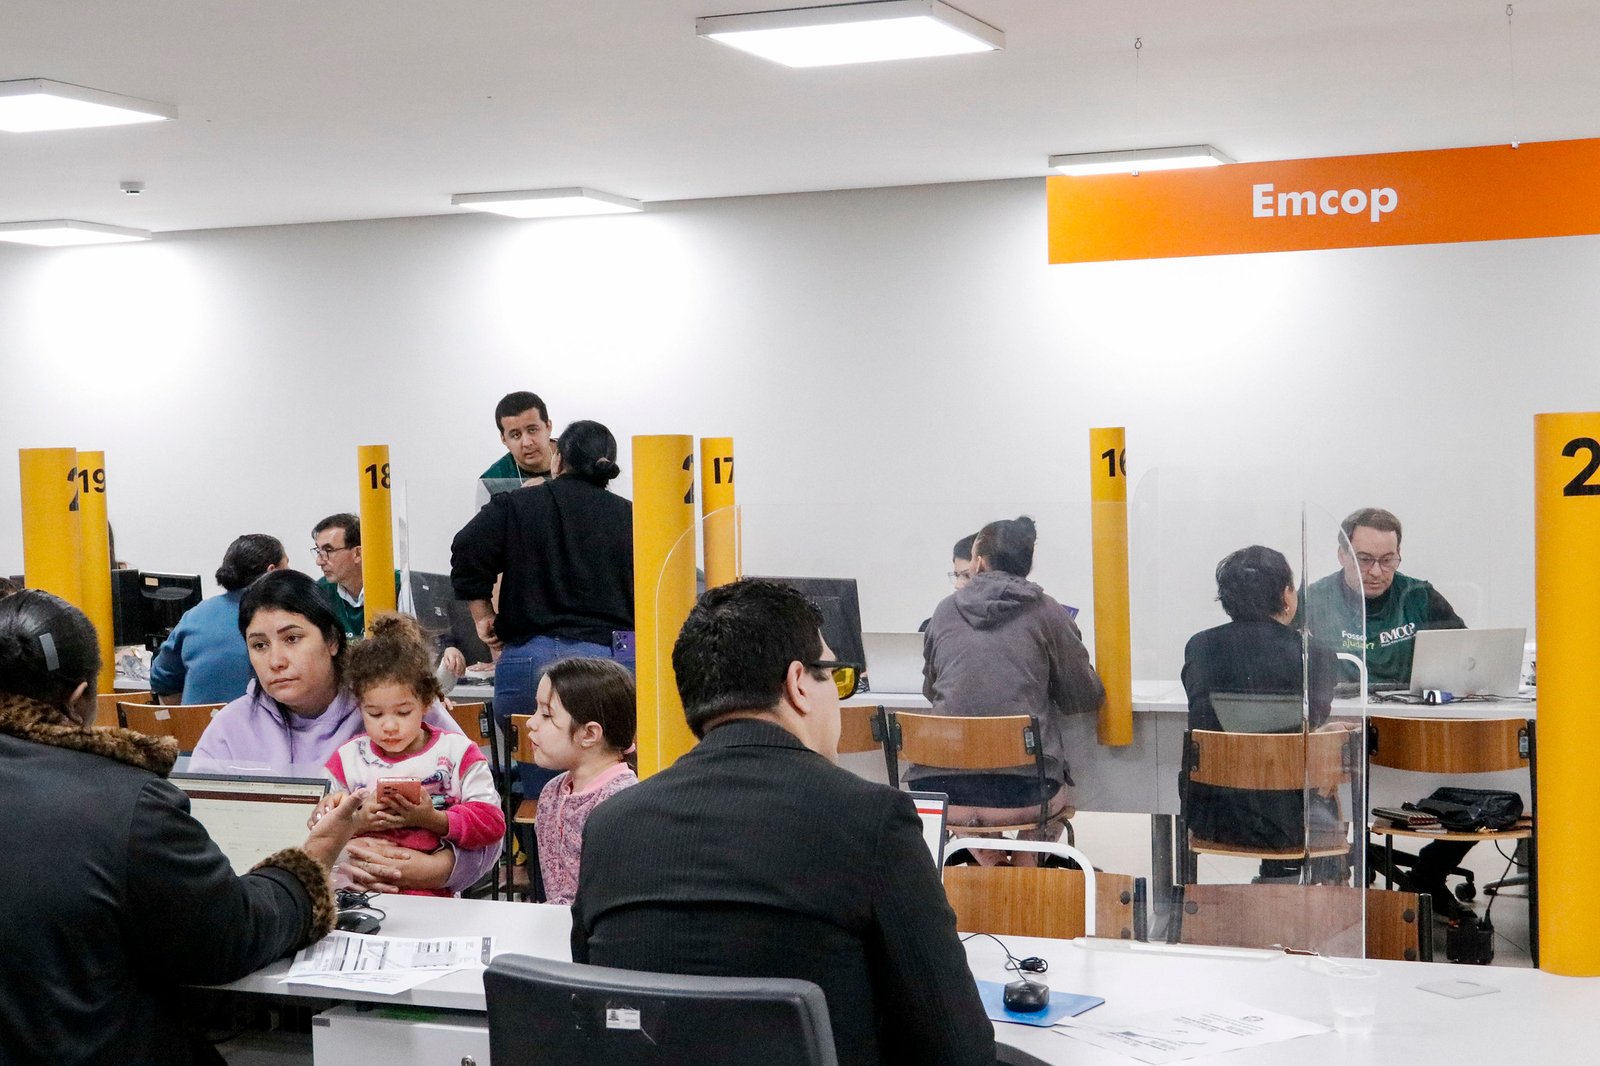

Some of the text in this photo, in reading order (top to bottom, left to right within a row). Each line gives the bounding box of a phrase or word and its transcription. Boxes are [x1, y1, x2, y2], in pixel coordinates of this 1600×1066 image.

[1252, 183, 1398, 222] Emcop
[365, 463, 390, 489] 18
[713, 457, 734, 484] 17
[1562, 437, 1600, 496] 2
[78, 468, 105, 493] 19
